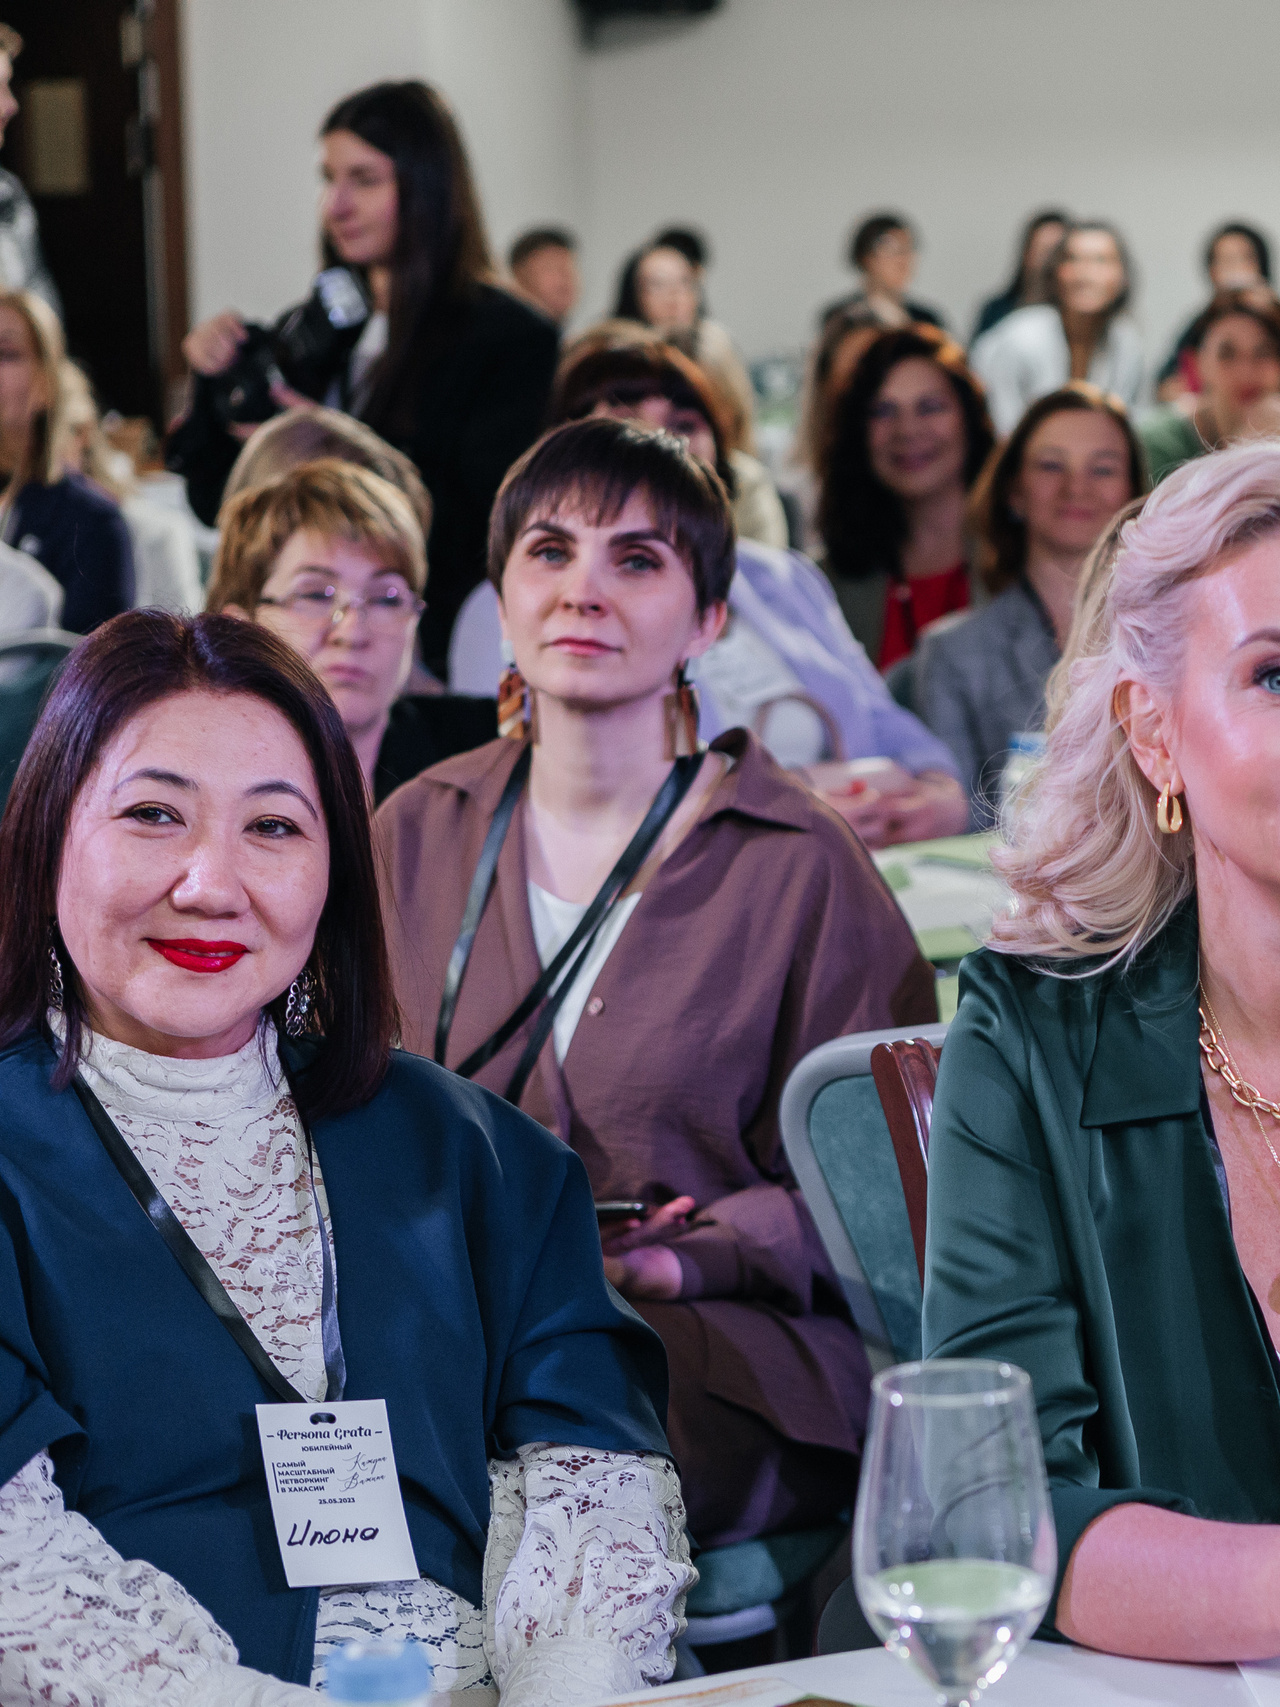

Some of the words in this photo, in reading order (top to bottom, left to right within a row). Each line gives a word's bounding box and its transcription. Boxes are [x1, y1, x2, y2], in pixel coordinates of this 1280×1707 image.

[276, 1429, 331, 1441] Persona
[334, 1425, 372, 1441] Grata
[301, 1443, 353, 1453] ЮБИЛЕЙНЫЙ
[276, 1460, 307, 1469] САМЫЙ
[277, 1467, 336, 1477] МАСШТАБНЫЙ
[279, 1476, 330, 1485] НЕТВОРКИНГ
[287, 1485, 325, 1493] ХАКАСИИ
[318, 1497, 356, 1505] 25.05.2023
[286, 1519, 380, 1547] Илона
